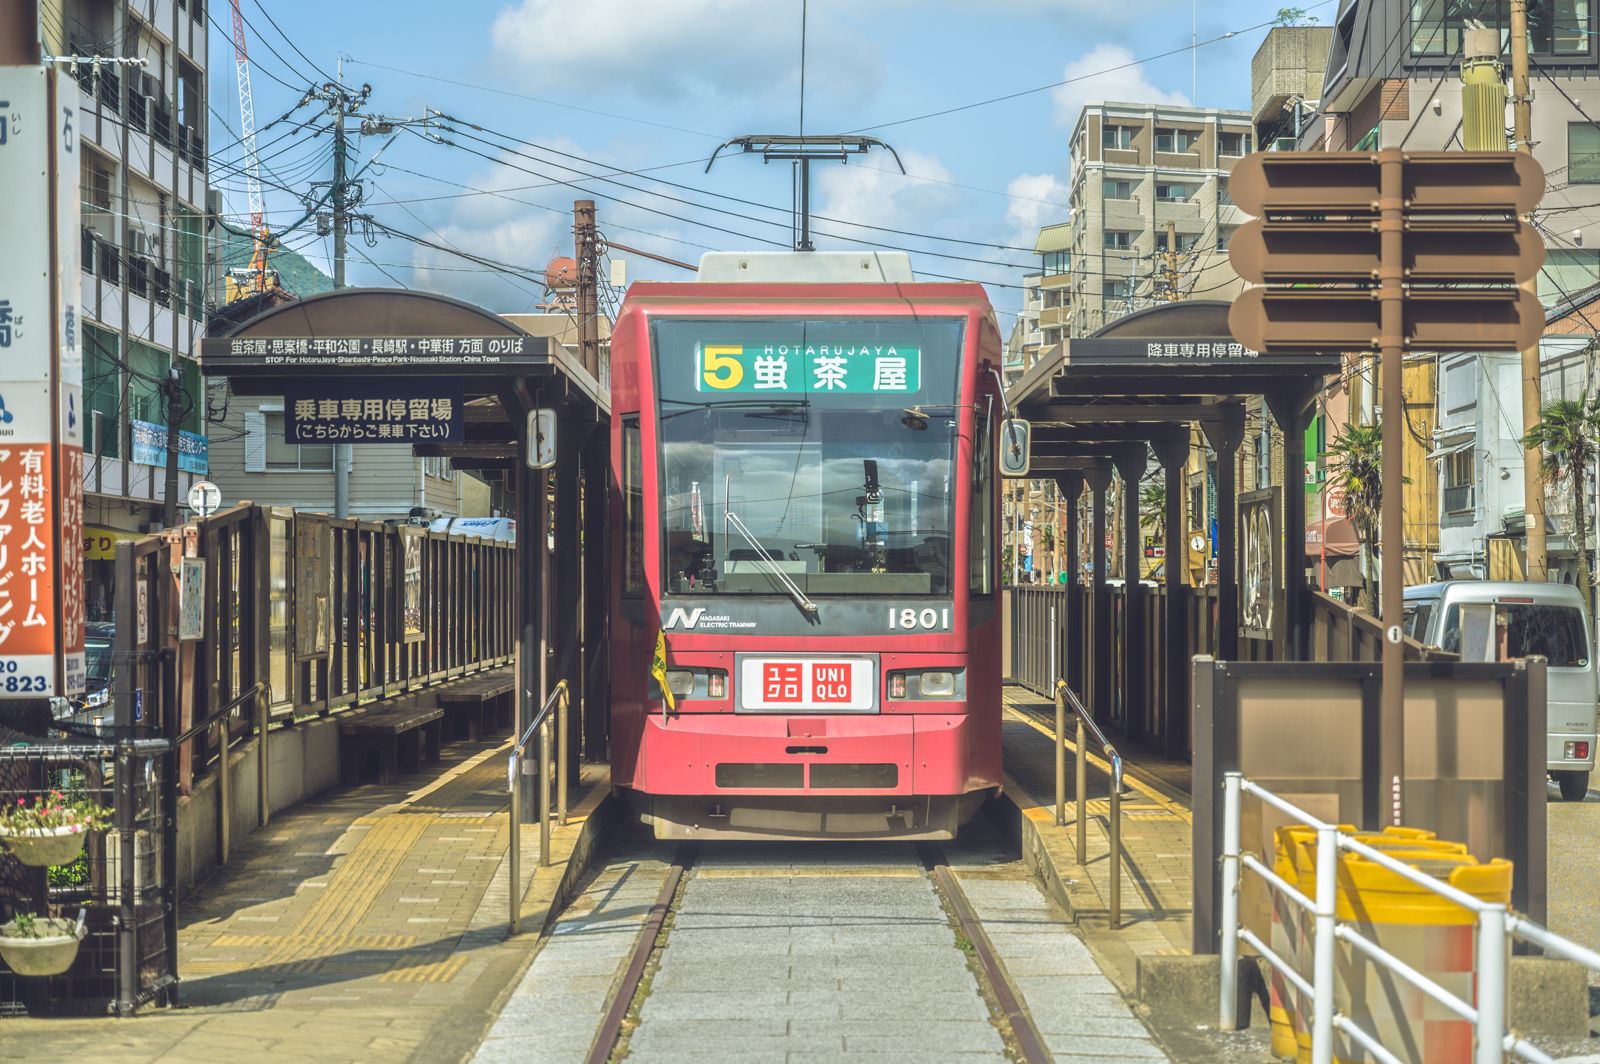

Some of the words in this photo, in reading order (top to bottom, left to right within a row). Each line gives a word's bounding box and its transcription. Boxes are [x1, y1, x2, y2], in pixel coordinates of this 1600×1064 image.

[459, 338, 483, 354] 方面
[488, 337, 524, 354] のりば
[763, 345, 898, 356] HOTARUJAYA
[265, 356, 284, 364] STOP
[286, 356, 298, 364] For
[482, 355, 500, 363] Town
[703, 344, 744, 390] 5
[753, 355, 908, 391] 蛍茶屋
[294, 398, 453, 421] 乗車専用停留場
[295, 423, 450, 439] （こちらからご乗車下さい）
[19, 448, 47, 627] 有料老人ホーム
[888, 607, 949, 630] 1801
[768, 667, 797, 682] ユニ
[816, 667, 845, 682] UNI
[768, 684, 798, 698] クロ
[816, 684, 847, 700] QLO
